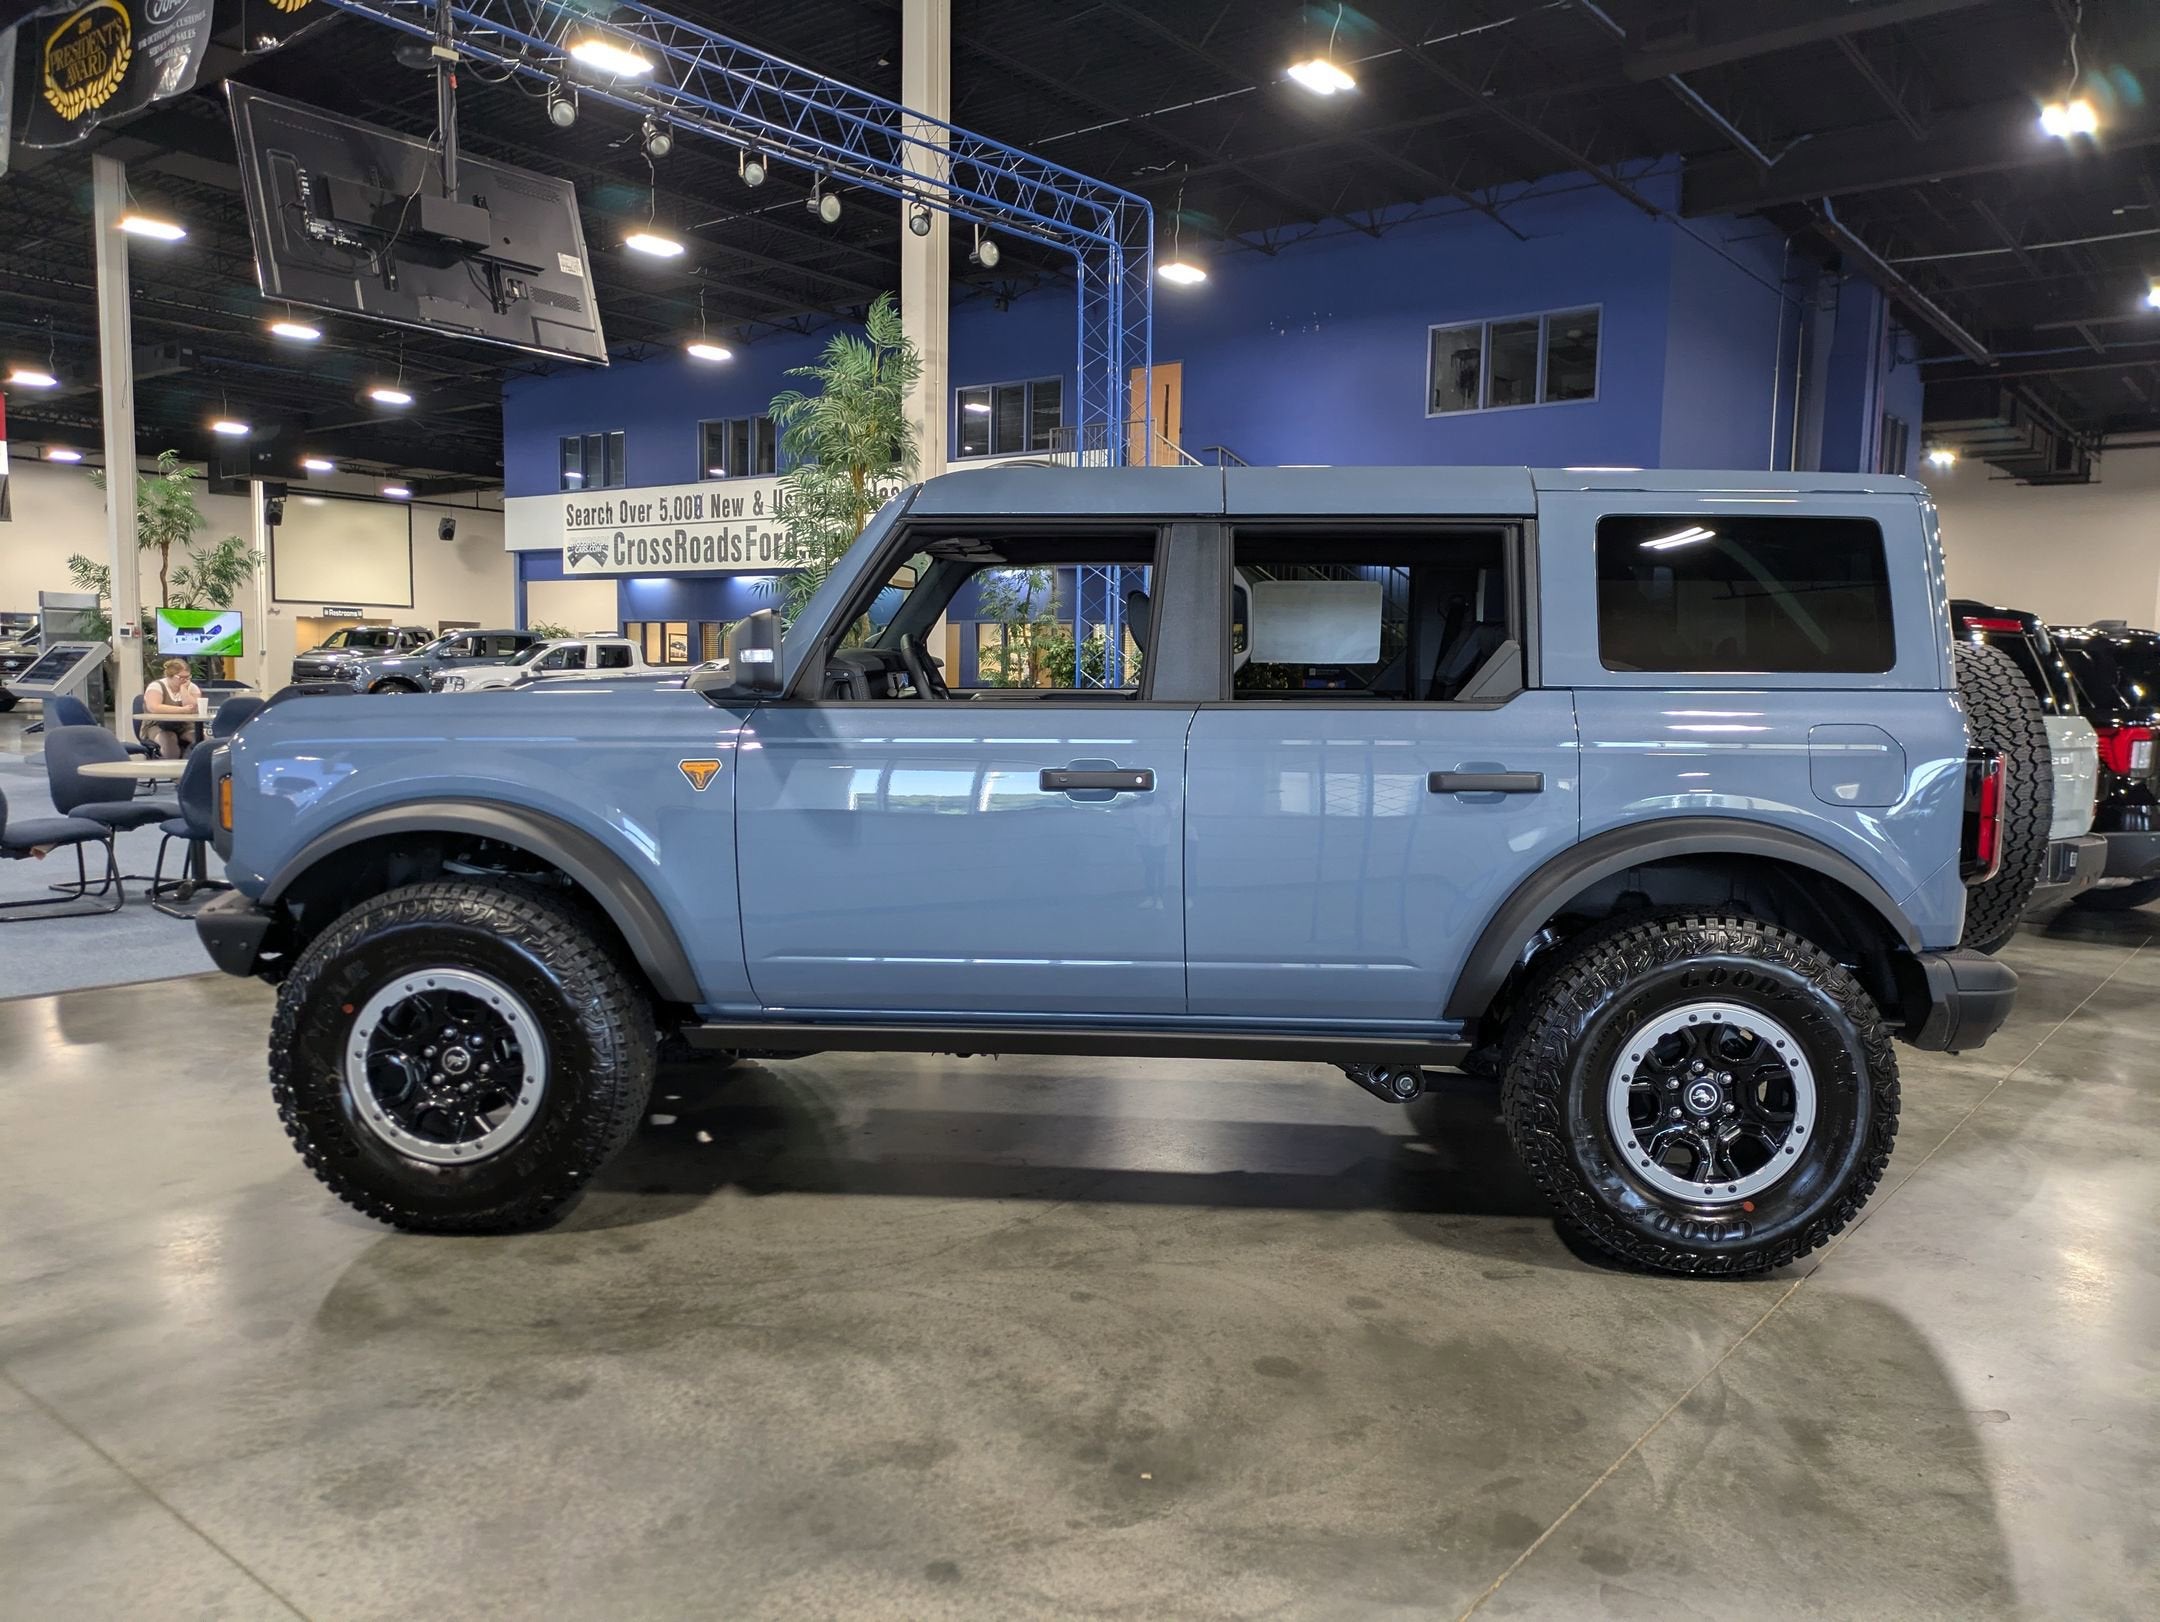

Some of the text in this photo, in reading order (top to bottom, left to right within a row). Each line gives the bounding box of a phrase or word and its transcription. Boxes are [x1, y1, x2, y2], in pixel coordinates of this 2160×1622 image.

[66, 49, 107, 88] AWARD
[566, 502, 613, 527] Search
[620, 500, 652, 524] Over
[711, 494, 744, 518] New
[753, 490, 764, 515] &
